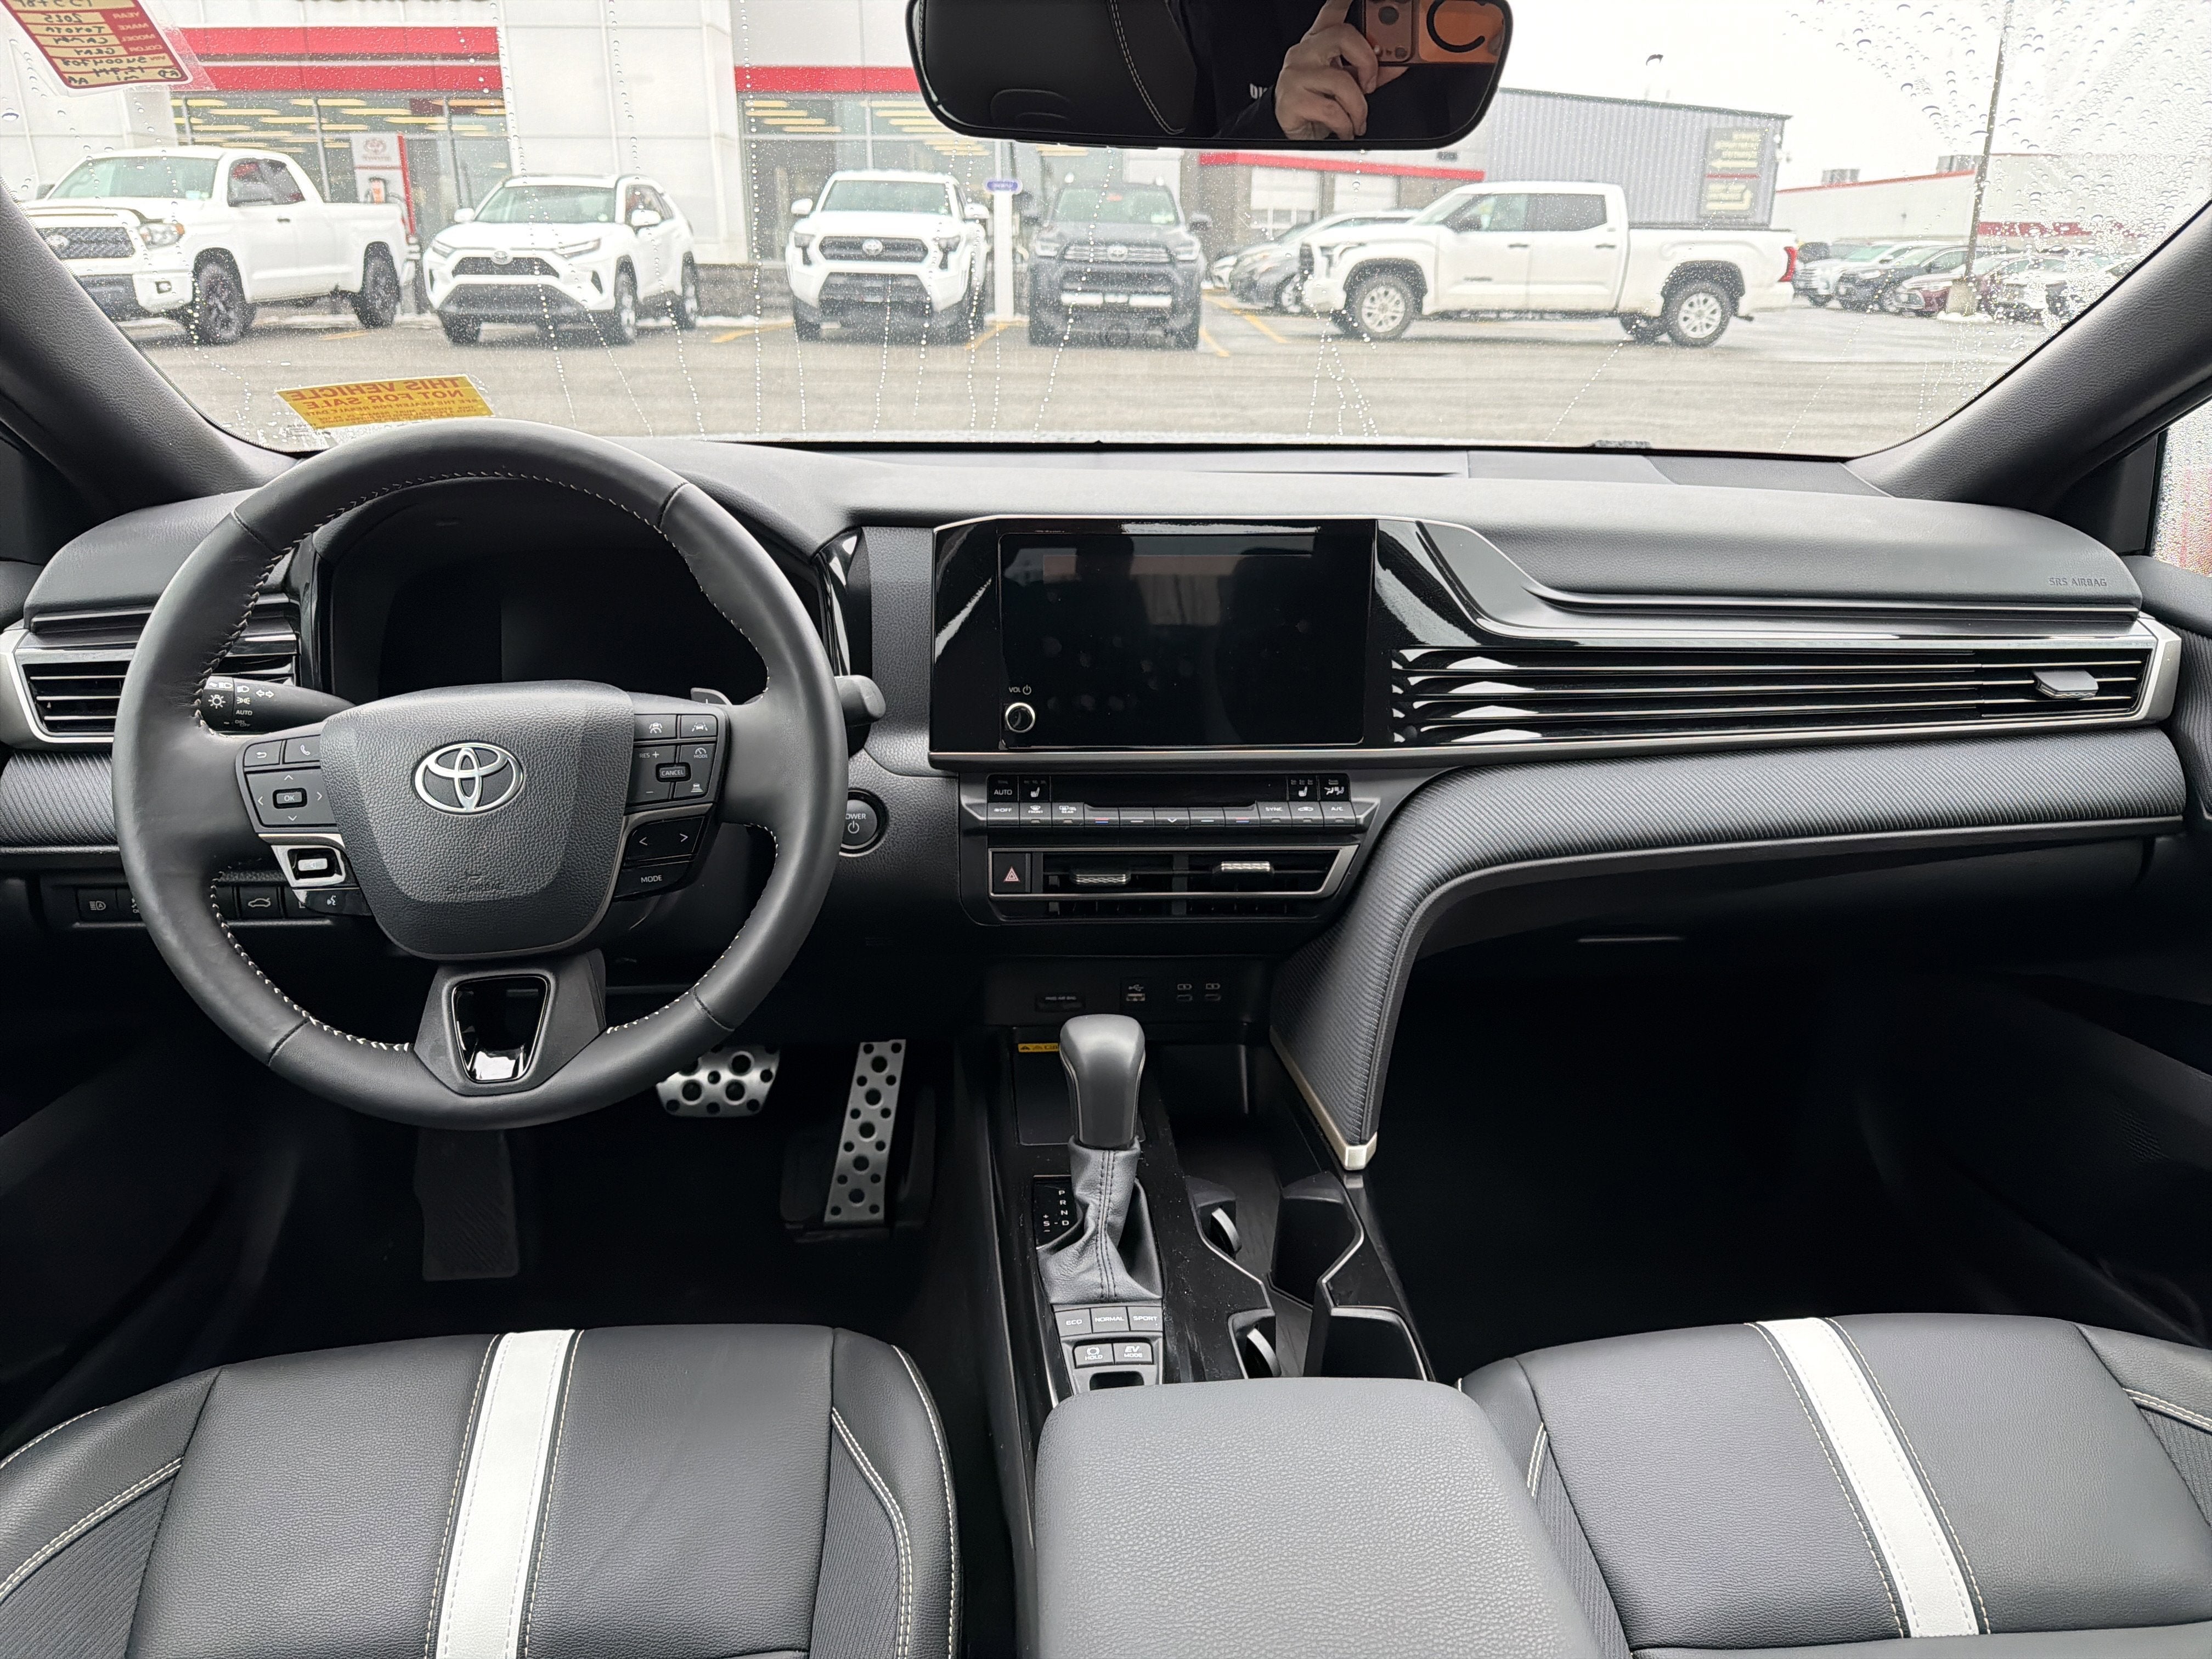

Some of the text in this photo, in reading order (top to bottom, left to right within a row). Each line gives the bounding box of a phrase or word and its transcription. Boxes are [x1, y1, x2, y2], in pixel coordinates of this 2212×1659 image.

[2049, 578, 2107, 587] SRS AIRBAG
[641, 874, 662, 883] MODE
